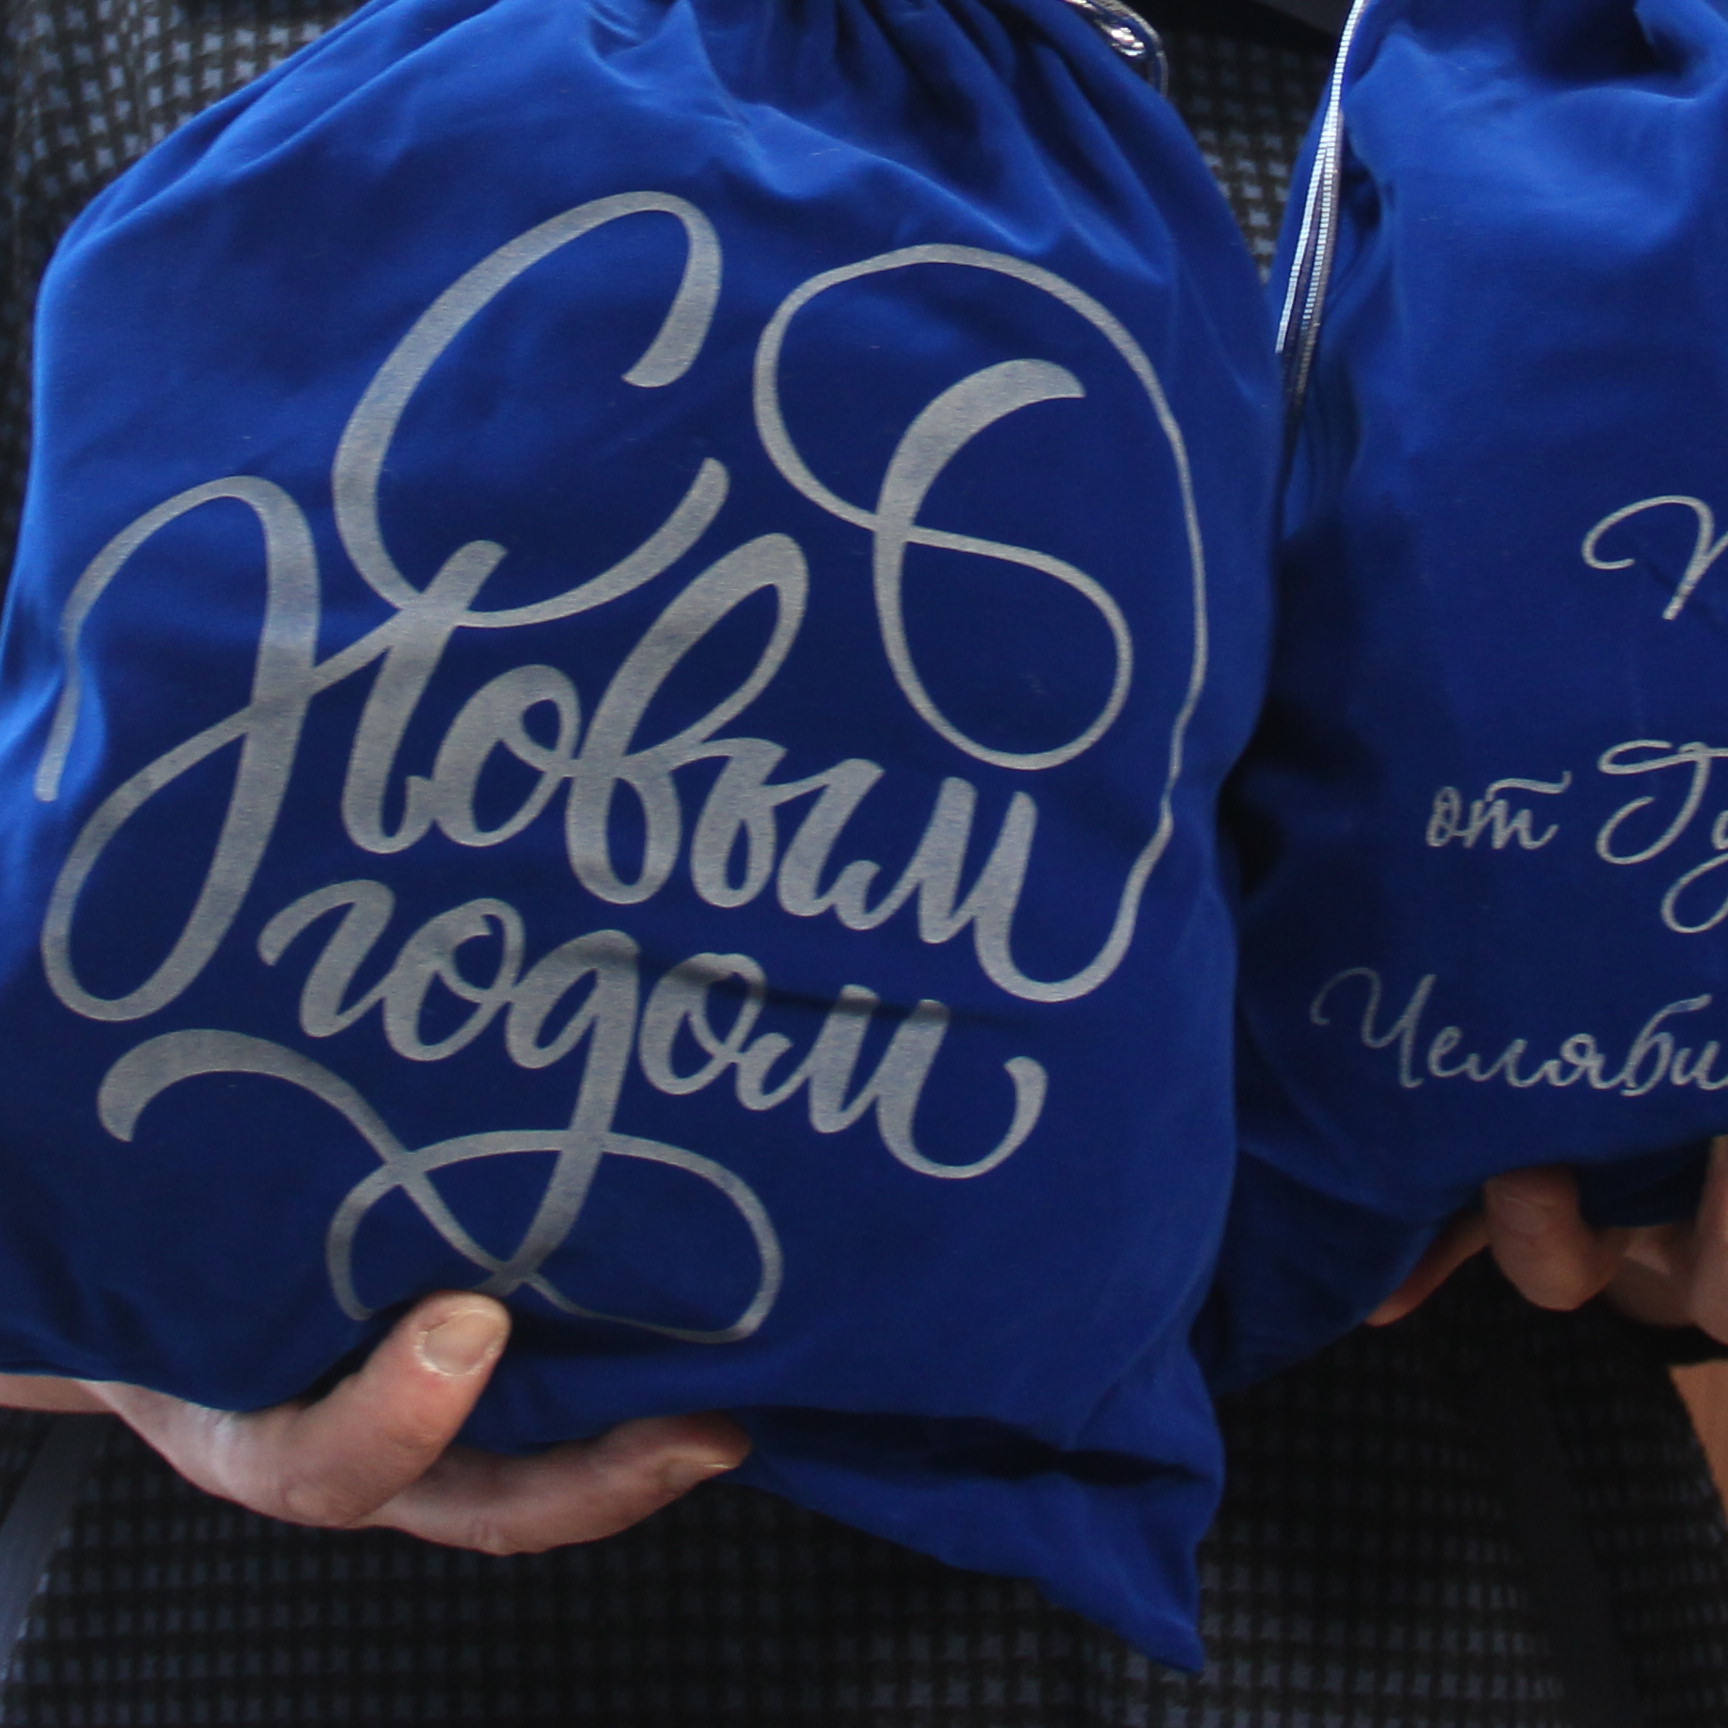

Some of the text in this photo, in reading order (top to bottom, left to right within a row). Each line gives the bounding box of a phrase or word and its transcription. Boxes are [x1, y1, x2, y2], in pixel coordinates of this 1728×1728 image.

[34, 244, 1208, 1024] Новым
[332, 190, 730, 628] С
[1427, 771, 1571, 849] от
[96, 876, 1048, 1344] годом
